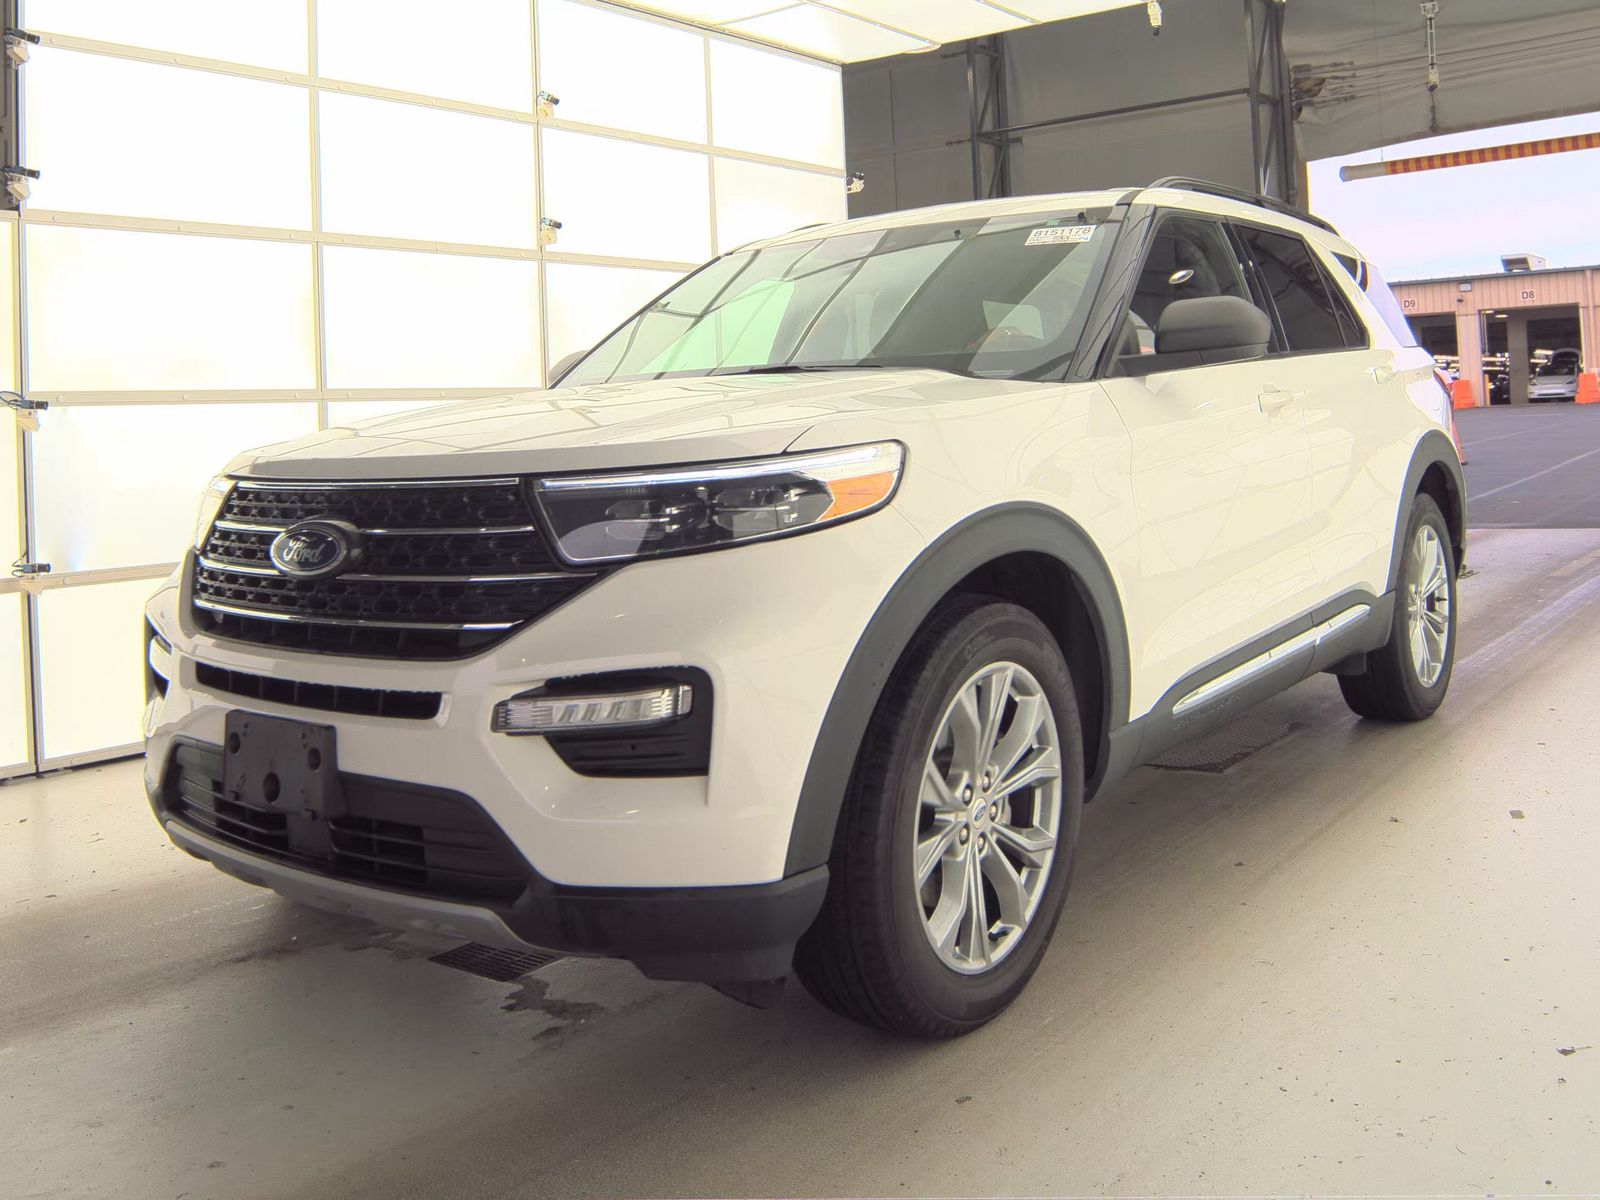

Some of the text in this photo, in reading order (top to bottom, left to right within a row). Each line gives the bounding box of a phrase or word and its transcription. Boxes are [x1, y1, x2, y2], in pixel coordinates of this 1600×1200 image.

[1521, 290, 1535, 300] D8
[1403, 299, 1416, 308] D9
[283, 535, 326, 563] Ford
